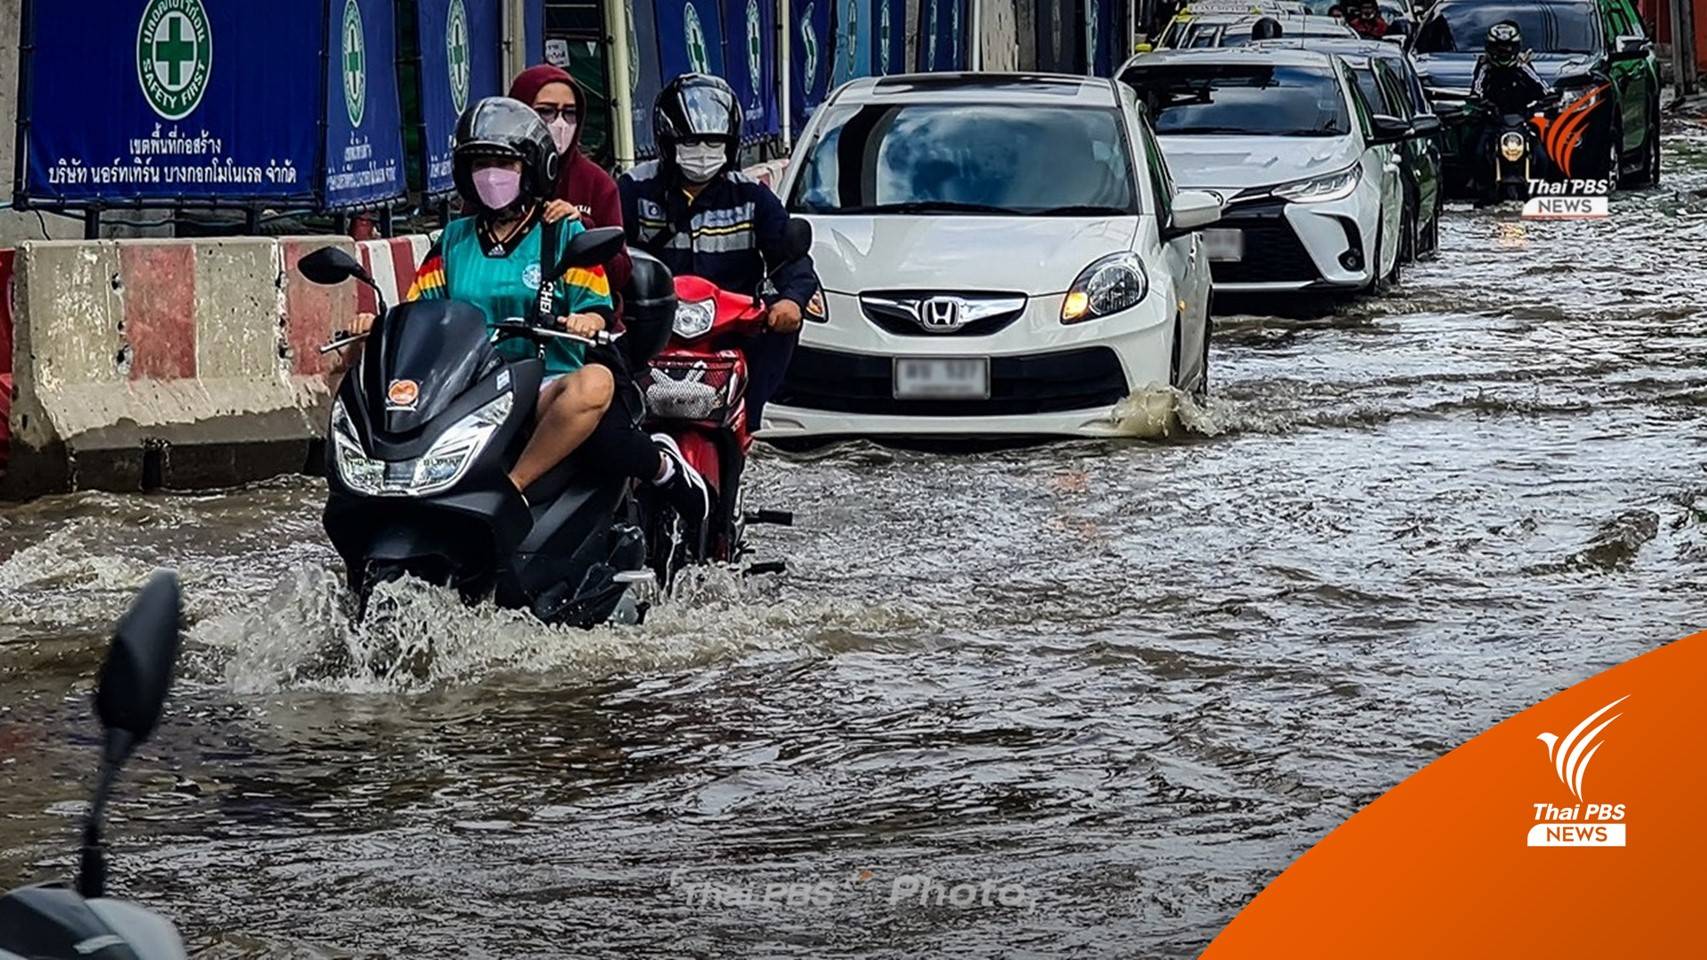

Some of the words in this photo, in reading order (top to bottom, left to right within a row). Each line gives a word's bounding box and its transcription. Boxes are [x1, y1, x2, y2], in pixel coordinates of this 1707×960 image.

[143, 58, 177, 109] SAFETY
[181, 59, 205, 106] FIRST
[129, 122, 221, 154] เขตพื้นที่ก่อสร้าง
[48, 158, 88, 183] บริษัท
[91, 157, 160, 183] นอร์ทเทิร์น
[164, 157, 262, 183] บางกอกโมโนเรล
[266, 158, 297, 183] จำกัด
